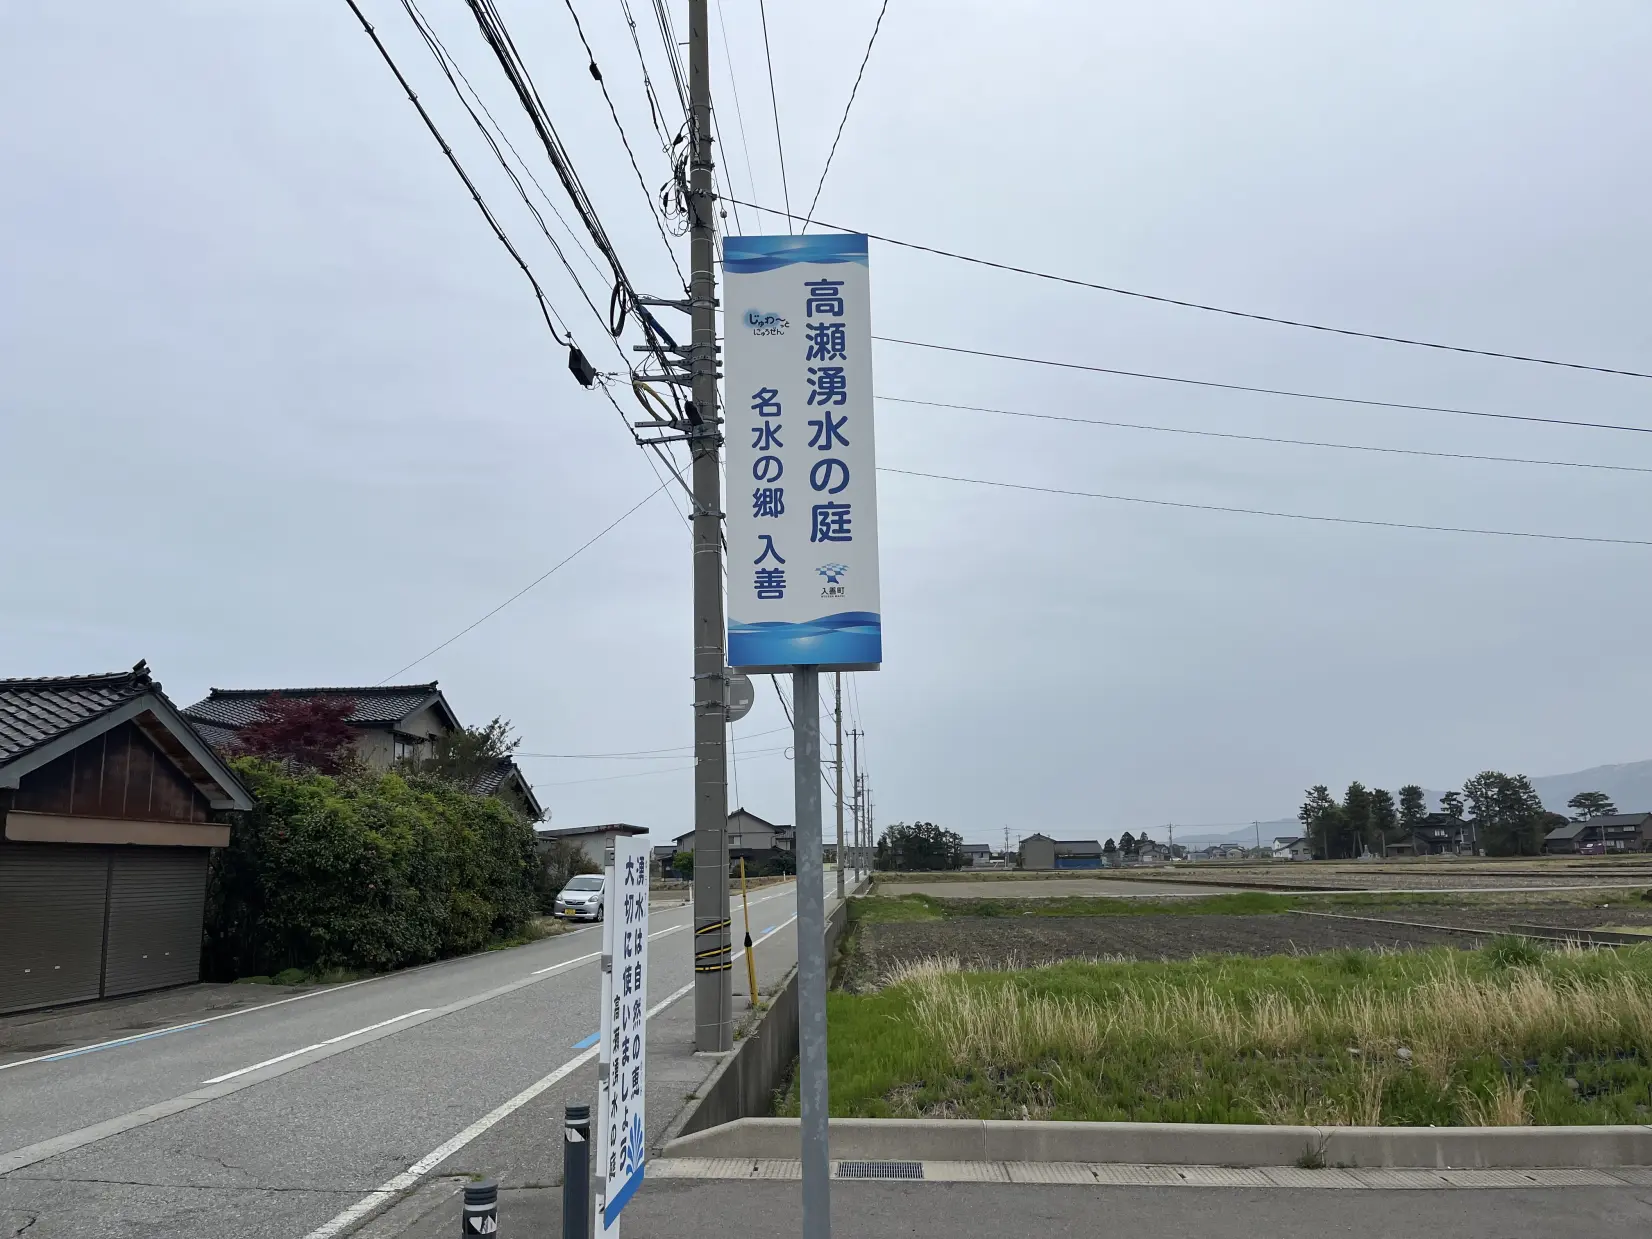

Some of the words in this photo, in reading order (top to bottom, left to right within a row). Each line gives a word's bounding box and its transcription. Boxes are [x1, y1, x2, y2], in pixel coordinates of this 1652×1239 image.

[753, 327, 785, 336] にゅうぜん
[751, 387, 785, 518] 名水の郷
[804, 279, 852, 543] 高瀬湧水の庭
[754, 534, 787, 600] 入善
[619, 855, 634, 1172] 大切に使いましょう
